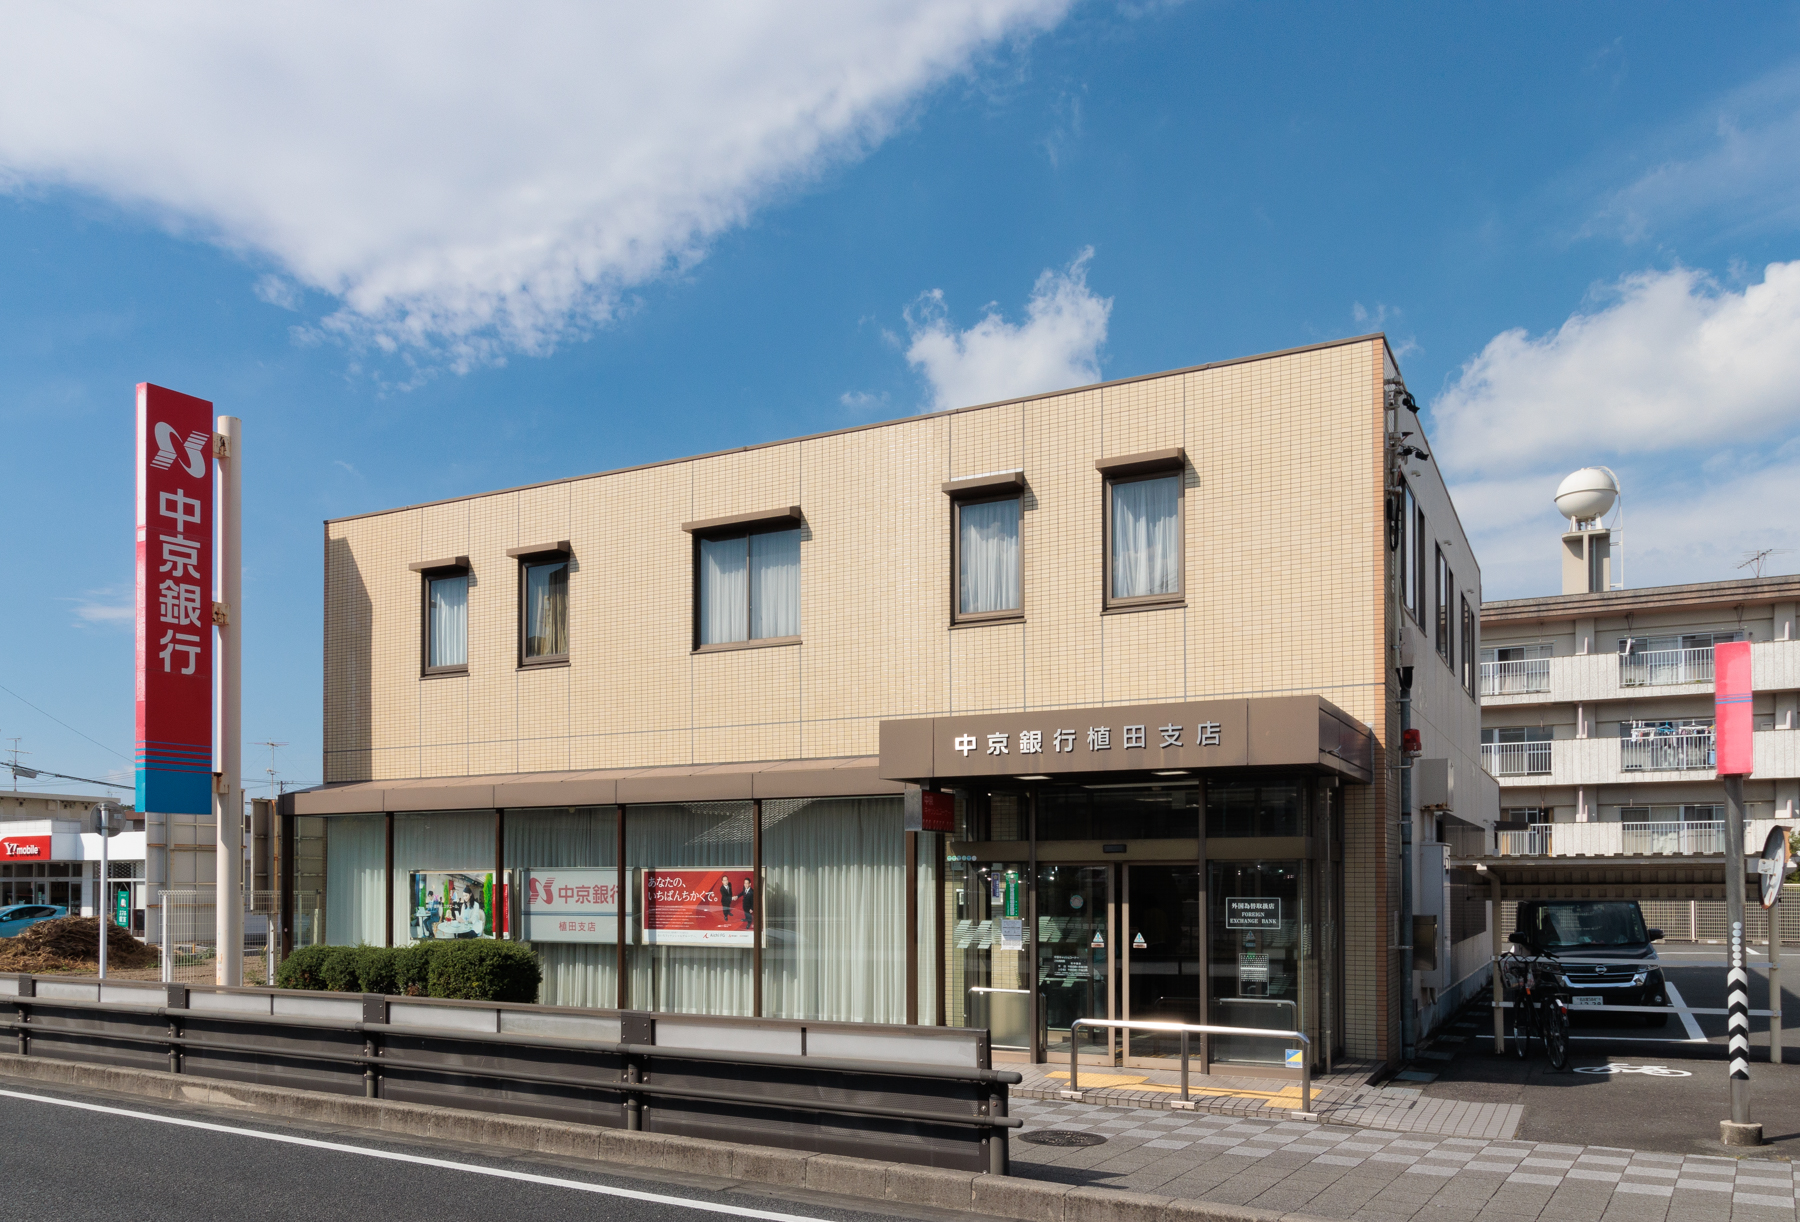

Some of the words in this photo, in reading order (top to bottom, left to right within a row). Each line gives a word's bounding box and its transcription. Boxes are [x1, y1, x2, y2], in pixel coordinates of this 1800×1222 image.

[159, 488, 201, 675] 中京銀行
[954, 720, 1221, 757] 中京銀行植田支店
[3, 842, 39, 855] Y!mobile
[648, 876, 686, 888] あなたの、
[648, 890, 719, 902] いちばんちかくで。
[558, 921, 596, 932] 植田支店
